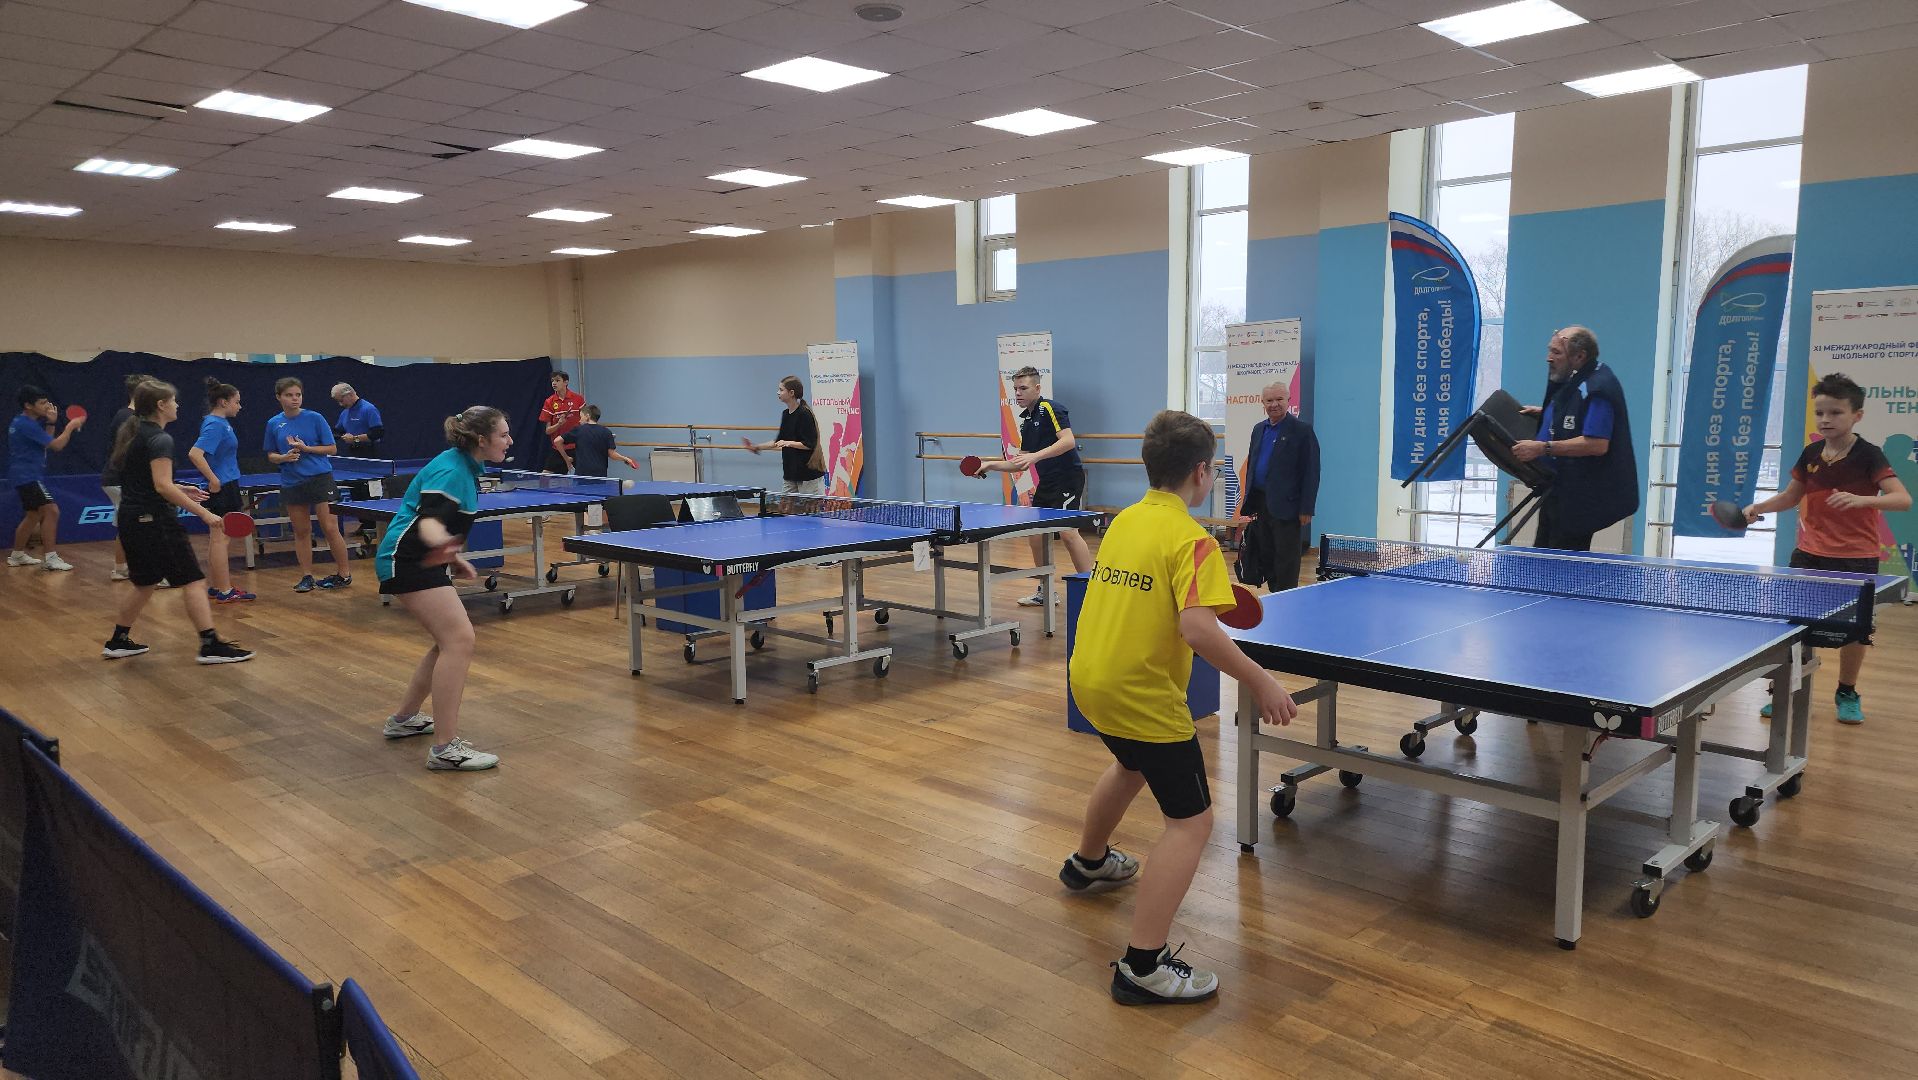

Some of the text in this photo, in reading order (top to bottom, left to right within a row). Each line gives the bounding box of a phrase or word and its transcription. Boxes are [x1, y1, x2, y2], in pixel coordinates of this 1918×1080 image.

[1438, 300, 1454, 369] победы!
[1823, 341, 1906, 352] МЕЖДУНАРОДНЫЙ
[1741, 331, 1761, 410] победы!
[1832, 352, 1886, 360] ШКОЛЬНОГО
[1410, 307, 1431, 464] Ни дня без спорта,
[1436, 373, 1451, 402] без
[1712, 339, 1736, 409] спорта,
[1226, 394, 1263, 405] НАСТОЛ
[1437, 407, 1450, 438] дня
[1705, 414, 1723, 447] без
[1732, 415, 1752, 447] без
[1706, 451, 1721, 486] дня
[726, 561, 760, 576] BUTTERFLY
